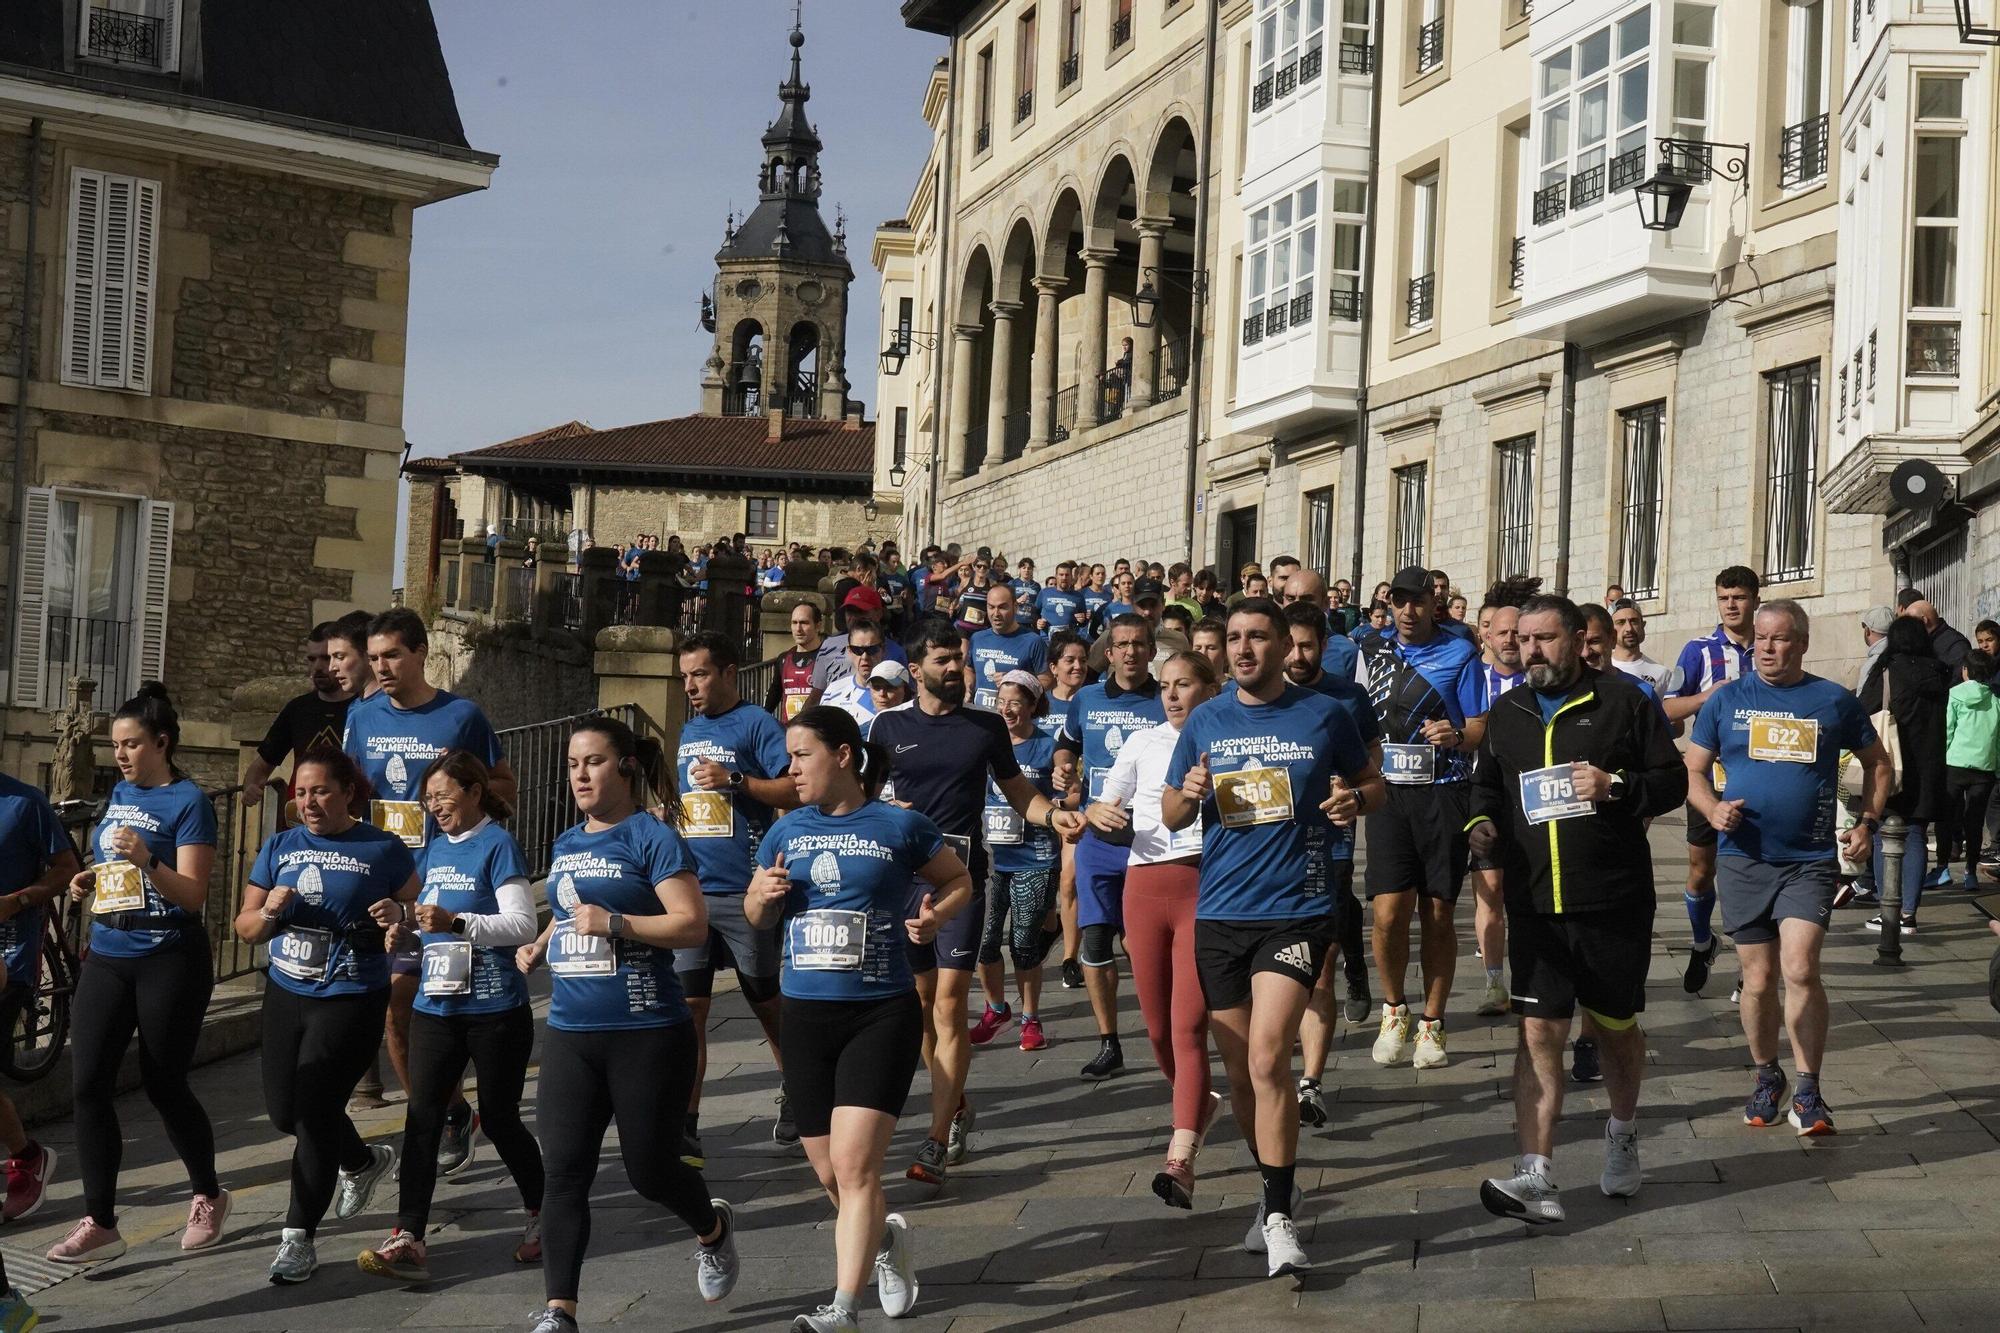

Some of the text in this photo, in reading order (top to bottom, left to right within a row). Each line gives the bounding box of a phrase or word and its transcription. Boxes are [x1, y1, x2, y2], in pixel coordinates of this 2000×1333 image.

[1096, 717, 1147, 725] ALMENDRA
[1746, 709, 1795, 719] CONQUISTA
[376, 736, 418, 744] CONQUISTA
[1211, 735, 1278, 749] LA CONQUISTA
[1768, 727, 1800, 746] 622
[375, 743, 434, 753] ALMENDRA
[1223, 742, 1299, 757] ALMENDRA
[404, 752, 445, 760] KONKIST
[704, 755, 736, 763] ONKISTA
[1264, 751, 1314, 762] KONKISTA
[1392, 753, 1422, 769] 1012
[1231, 780, 1272, 805] 556
[1540, 777, 1573, 801] 975
[693, 802, 711, 820] 52
[387, 812, 404, 829] 40
[988, 815, 1011, 830] 902
[788, 833, 857, 846] LA CONQUISTA
[798, 839, 879, 852] ALMENDRA
[279, 849, 339, 862] LA CONQUISTA
[289, 855, 358, 866] ALMENDRA
[839, 848, 893, 861] KONKISTA
[322, 863, 370, 876] KONKISTA
[551, 858, 607, 873] ALMENDRA
[574, 868, 622, 878] KONKISTA
[101, 872, 124, 893] 542
[440, 882, 475, 891] KONKISTA
[803, 924, 849, 947] 1008
[281, 936, 312, 960] 930
[560, 932, 598, 954] 1007
[427, 956, 449, 976] 773
[1274, 952, 1312, 976] adidas
